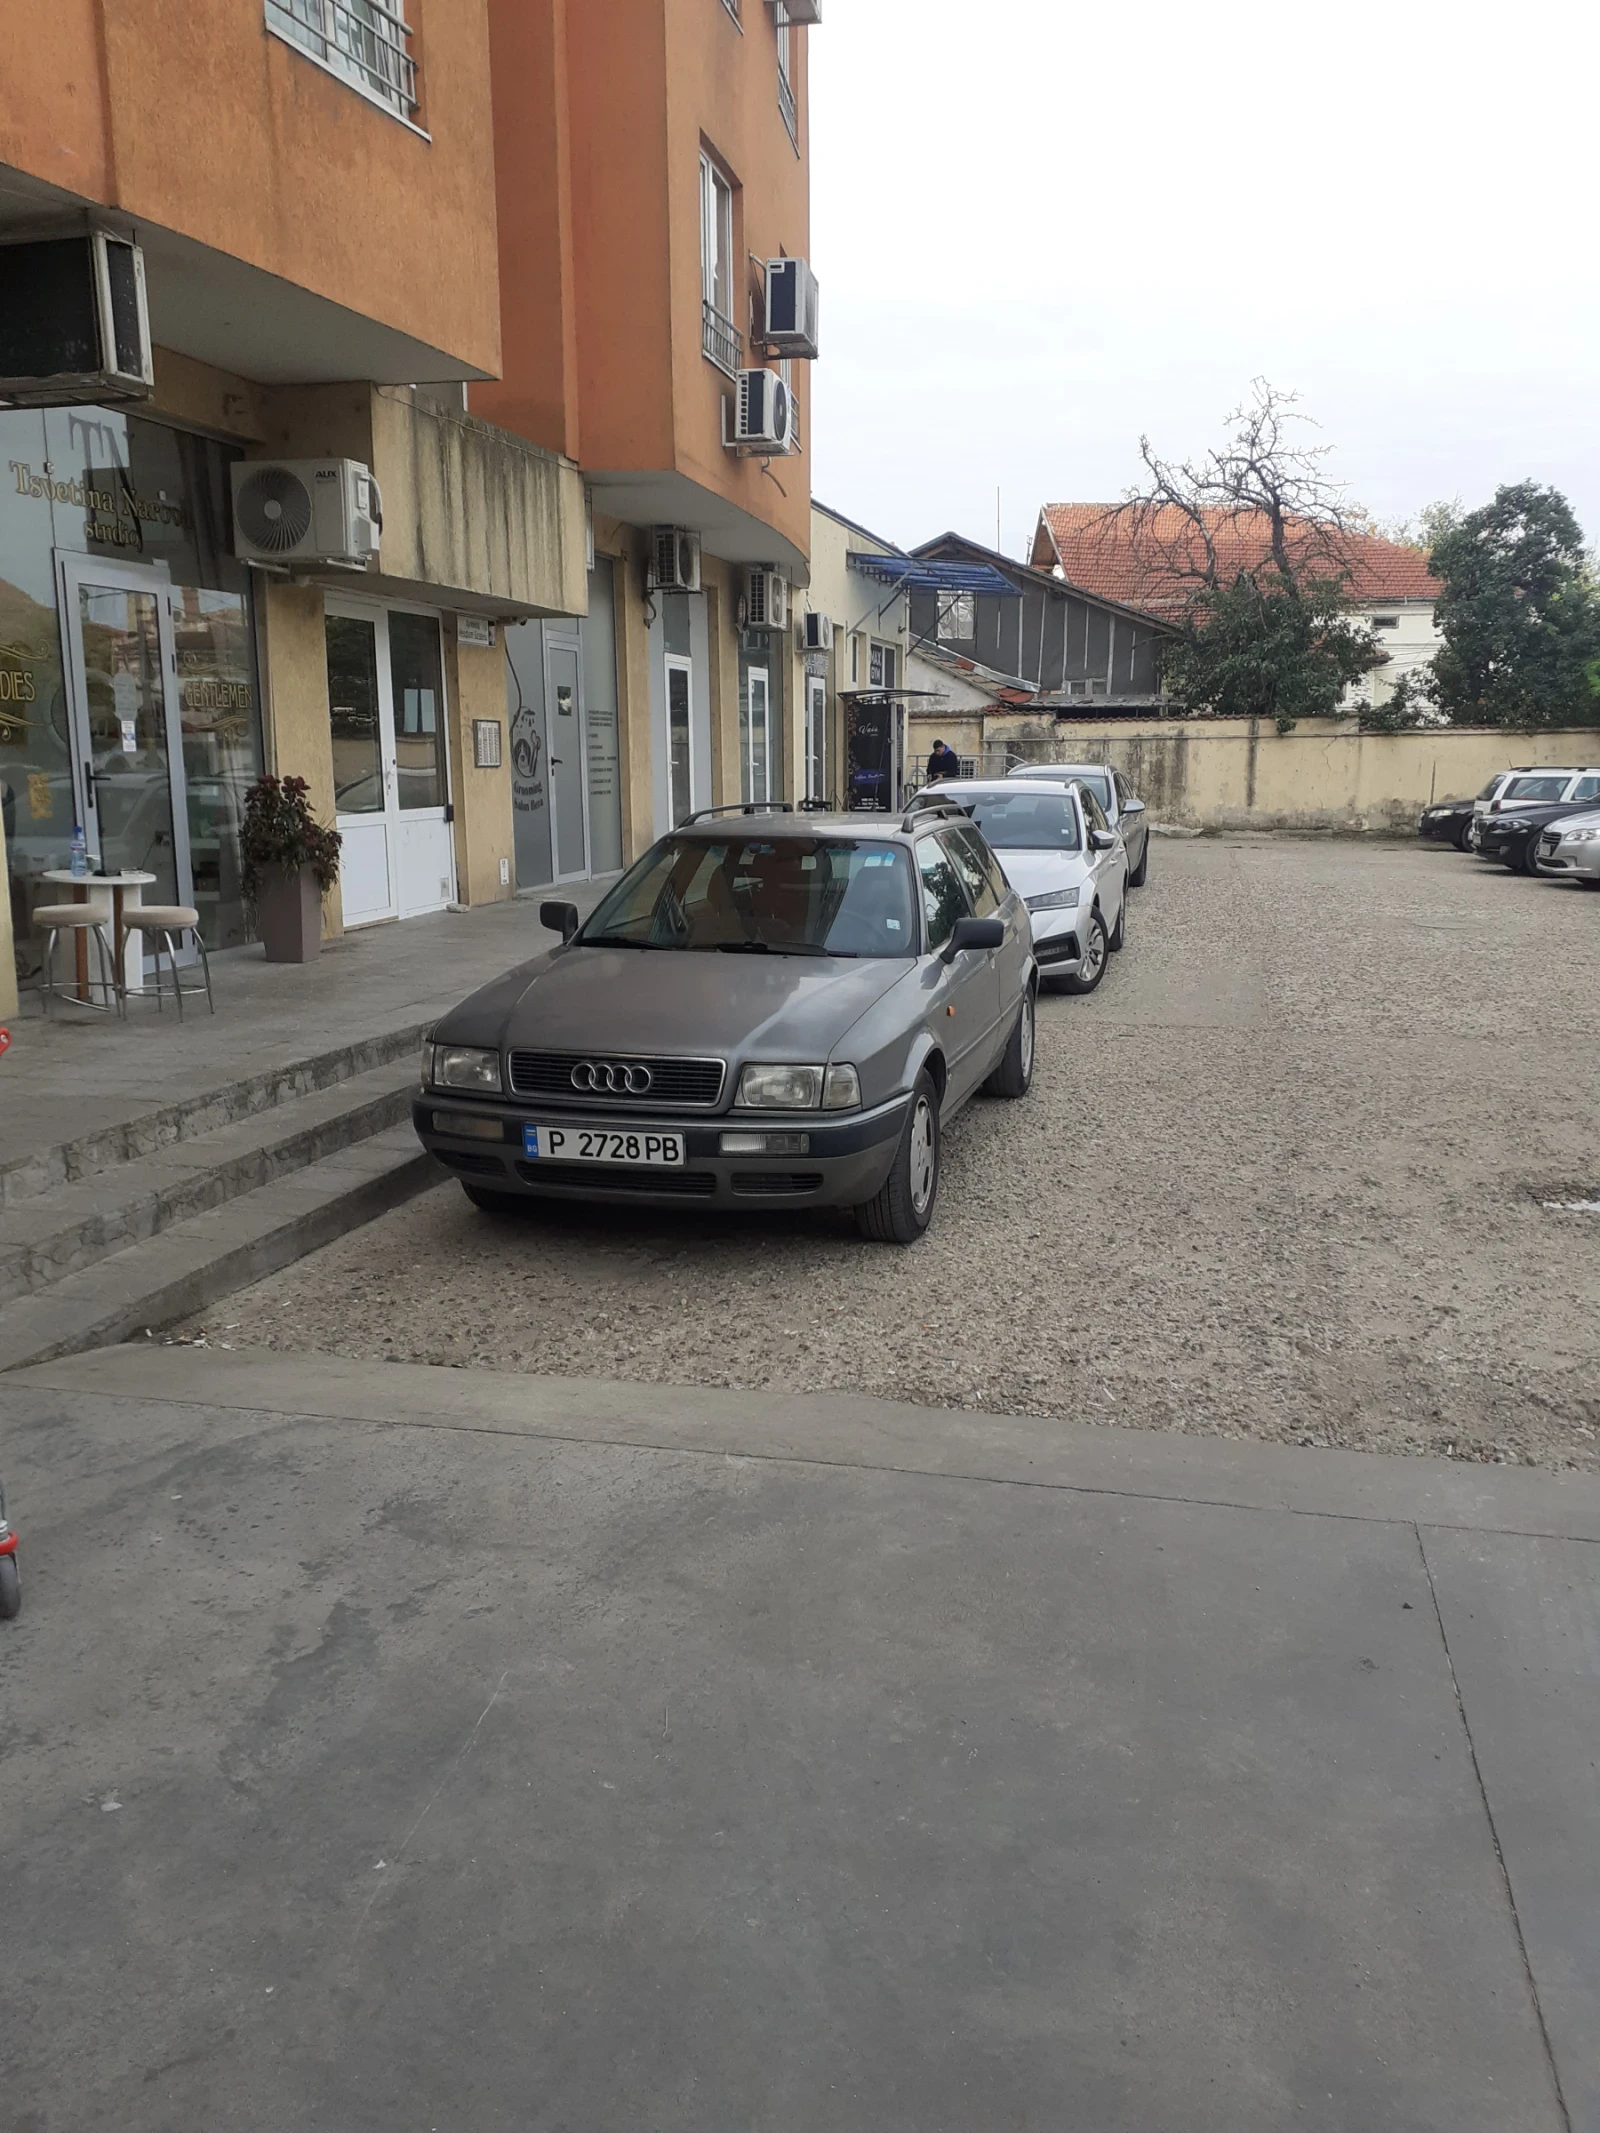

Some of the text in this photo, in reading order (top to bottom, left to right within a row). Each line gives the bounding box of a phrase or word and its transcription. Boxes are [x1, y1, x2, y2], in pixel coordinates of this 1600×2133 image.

[315, 470, 337, 478] AUX
[9, 460, 115, 513] Tsvetina
[84, 519, 140, 547] studio
[872, 650, 882, 667] MAX
[871, 666, 881, 681] GYM
[184, 681, 253, 709] GENTLEMEN
[527, 1144, 538, 1152] BG
[549, 1130, 565, 1155] P
